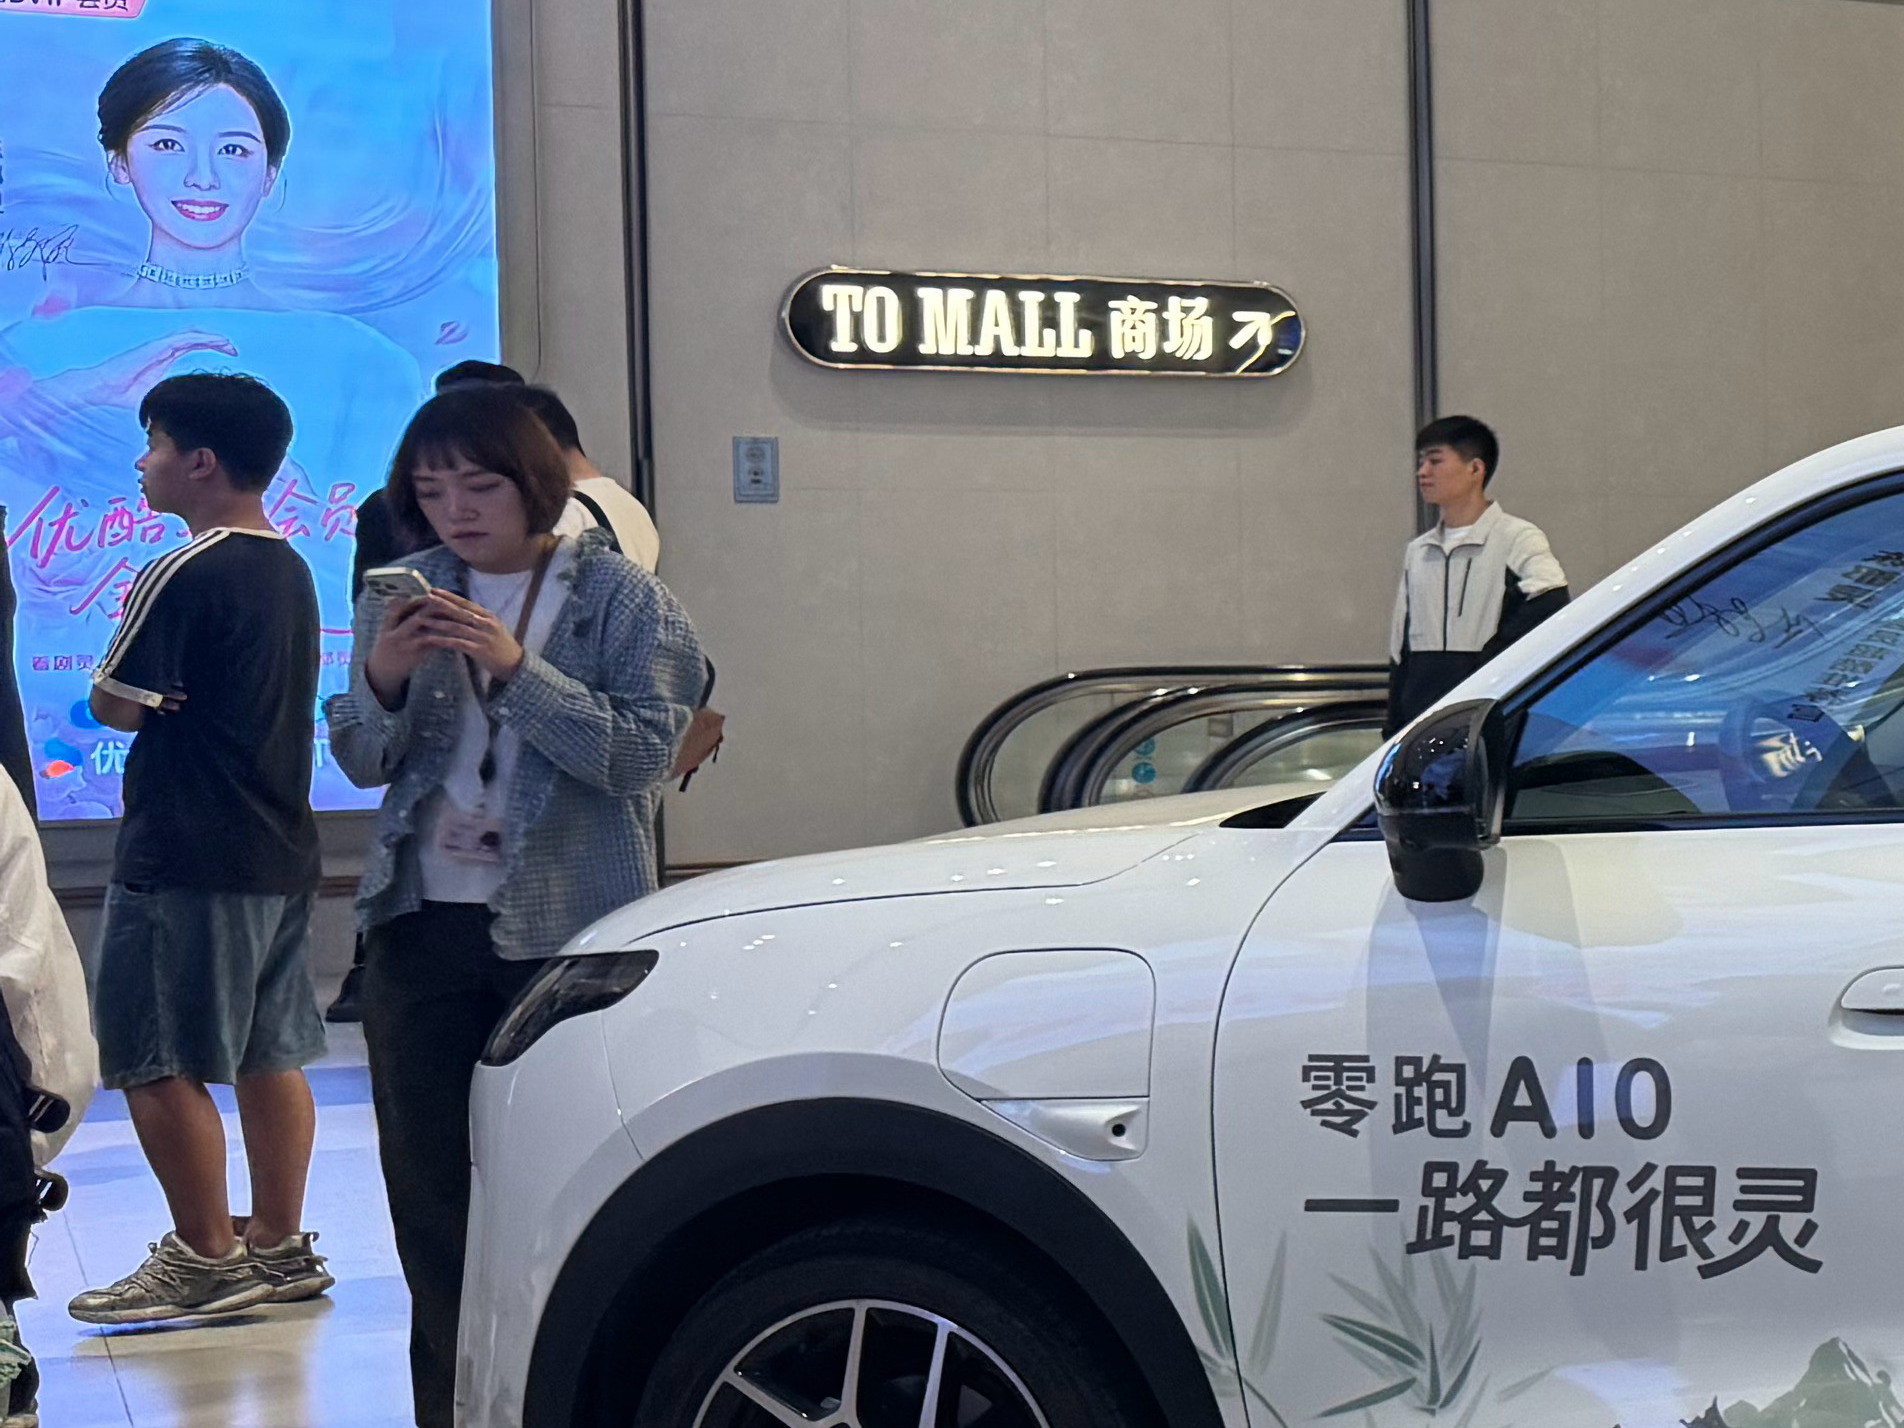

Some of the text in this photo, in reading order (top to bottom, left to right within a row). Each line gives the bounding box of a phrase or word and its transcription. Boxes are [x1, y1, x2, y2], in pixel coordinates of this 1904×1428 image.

[822, 285, 1214, 361] TO MALL 商场
[1303, 1159, 1824, 1280] 一路都很灵
